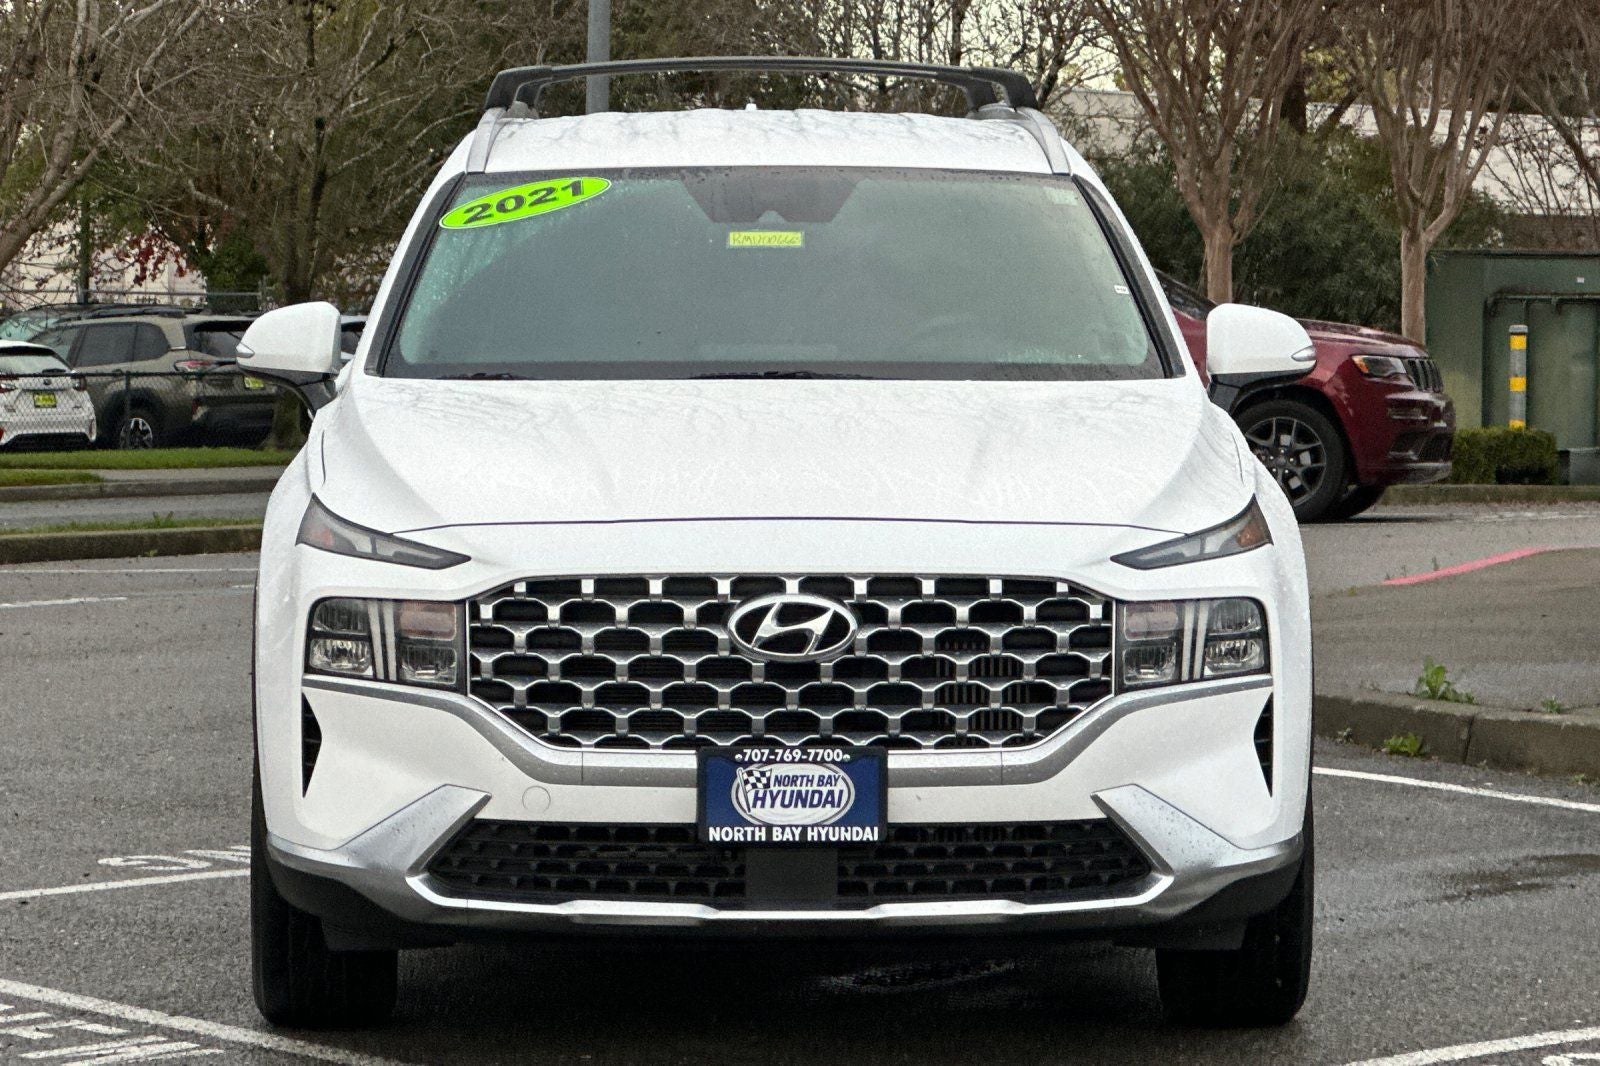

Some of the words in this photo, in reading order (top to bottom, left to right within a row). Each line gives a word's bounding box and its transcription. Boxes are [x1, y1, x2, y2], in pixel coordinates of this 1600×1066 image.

[463, 180, 584, 225] 2021
[743, 749, 843, 762] 707-769-7700
[773, 774, 812, 787] NORTH
[816, 774, 842, 787] BAY
[751, 790, 845, 809] HYUNDAI
[709, 827, 766, 841] NORTH
[772, 827, 803, 841] BAY
[807, 827, 879, 841] HYUNDAI
